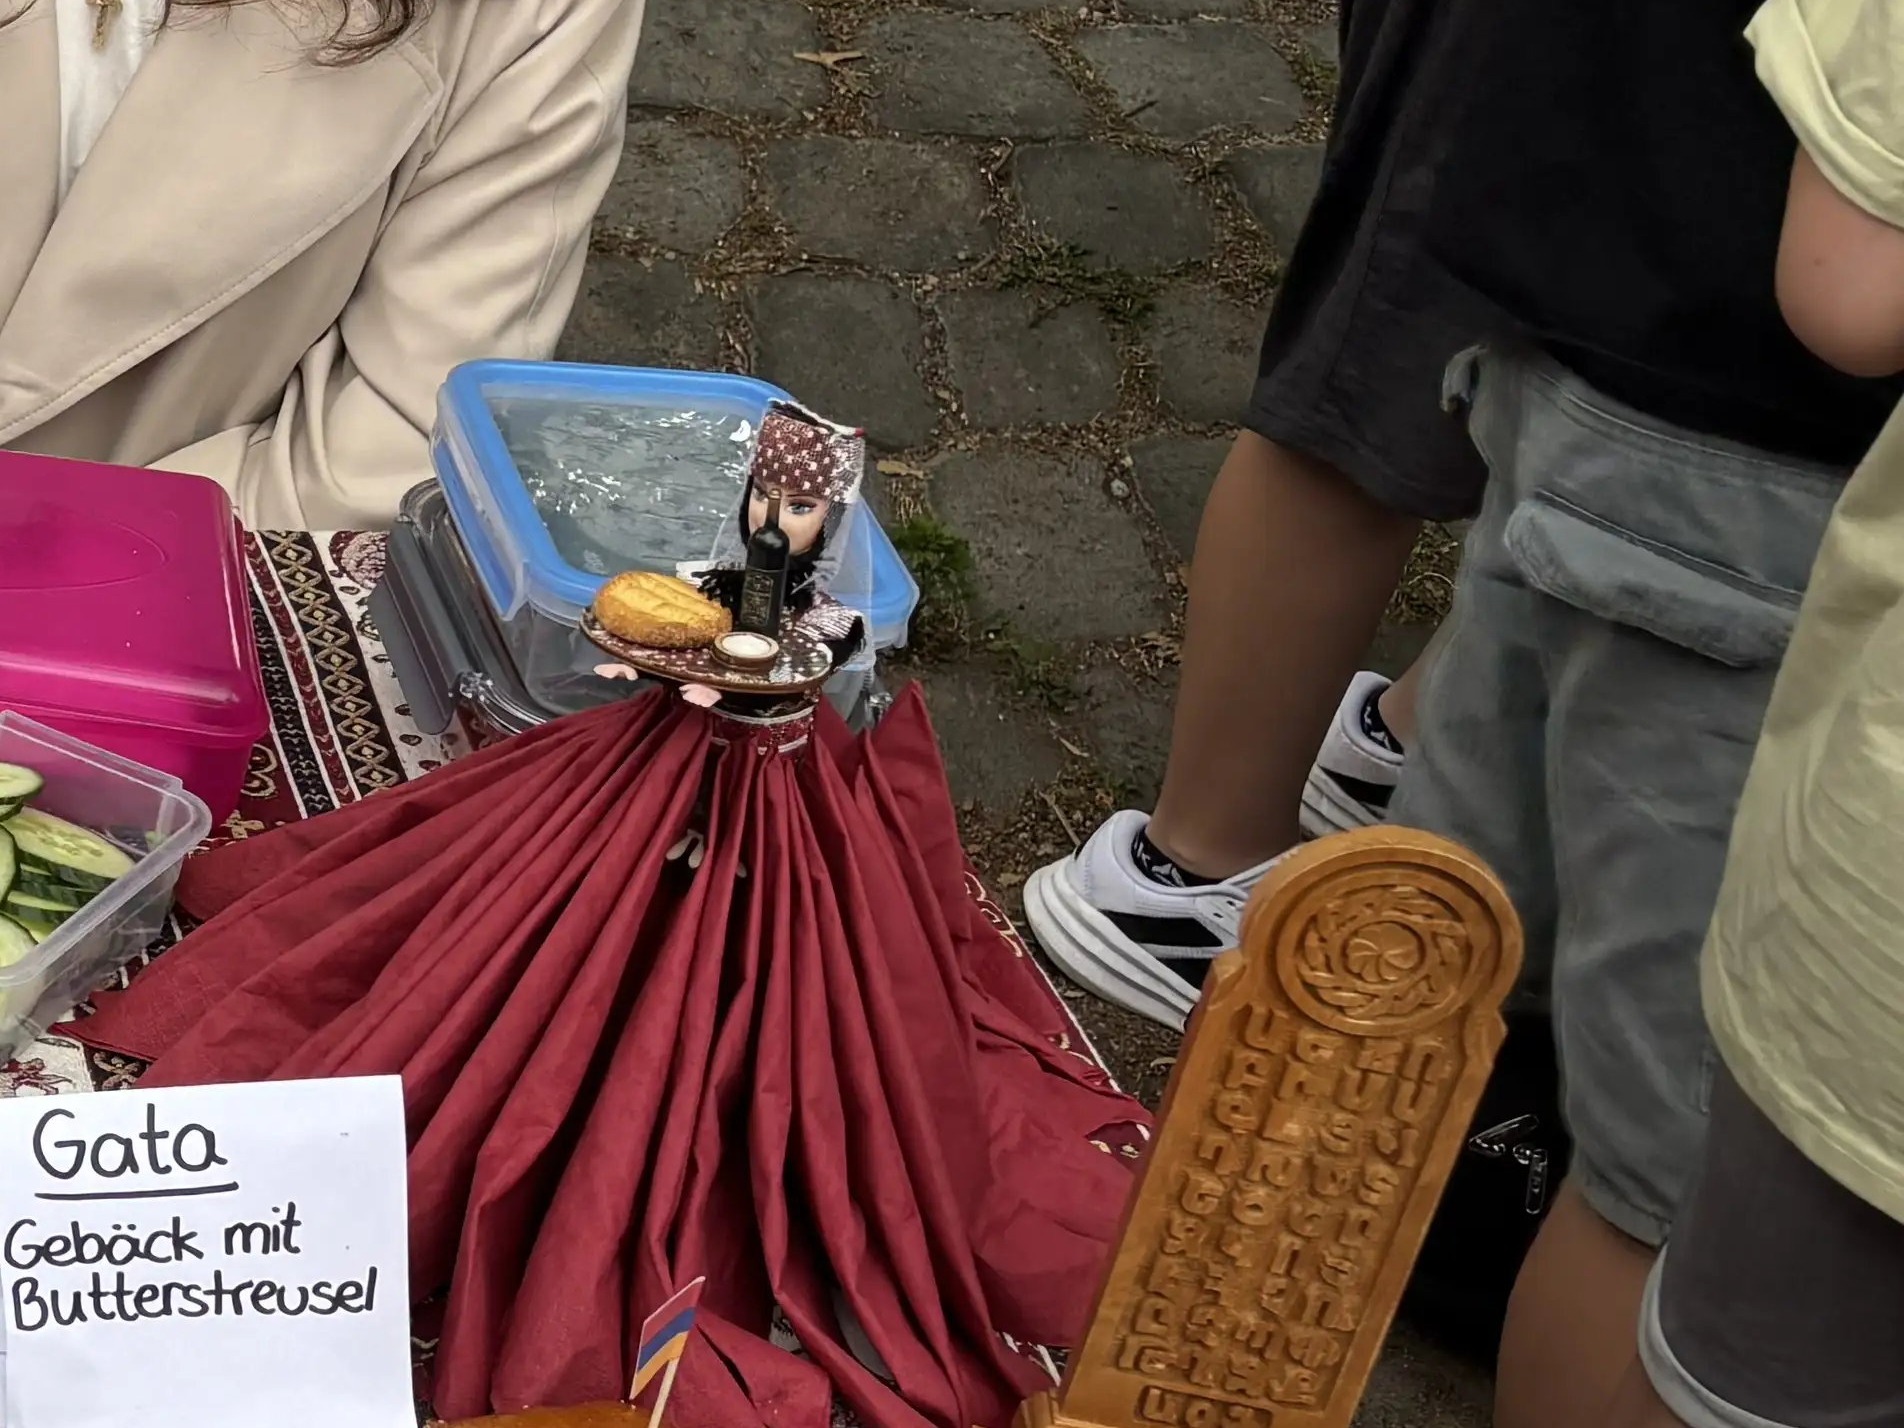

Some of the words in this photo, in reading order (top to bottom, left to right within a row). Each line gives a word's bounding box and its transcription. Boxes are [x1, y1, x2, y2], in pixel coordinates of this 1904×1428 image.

[32, 1102, 228, 1180] Gata
[3, 1216, 204, 1270] Gebäck
[224, 1201, 302, 1255] mit
[12, 1266, 378, 1332] Butterstreusel
